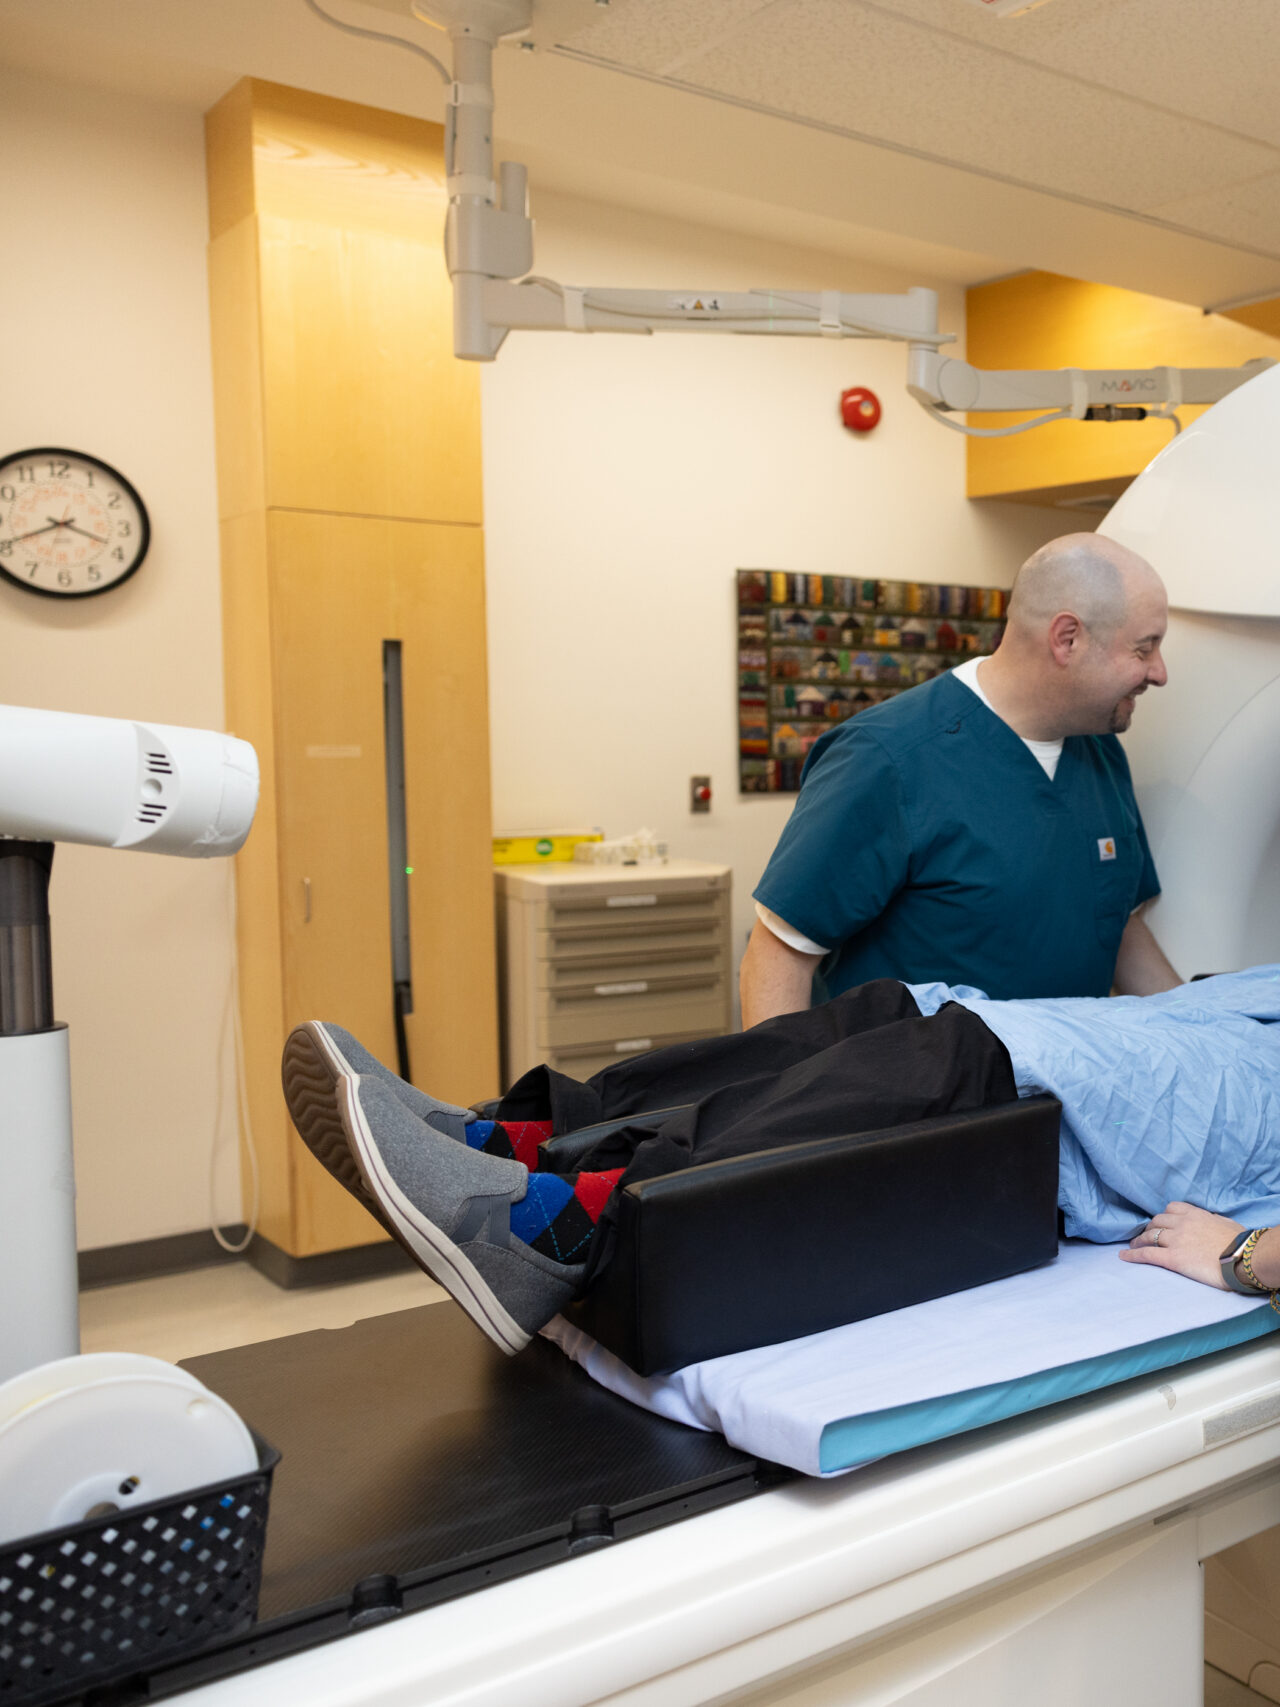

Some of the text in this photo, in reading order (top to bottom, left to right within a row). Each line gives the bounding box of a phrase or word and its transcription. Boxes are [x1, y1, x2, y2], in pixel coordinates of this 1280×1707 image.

[17, 465, 35, 482] 11
[48, 461, 70, 479] 12
[107, 492, 121, 509] 2
[118, 520, 131, 537] 3
[111, 545, 124, 562] 4
[25, 560, 38, 577] 7
[88, 565, 101, 582] 5
[57, 569, 71, 587] 6
